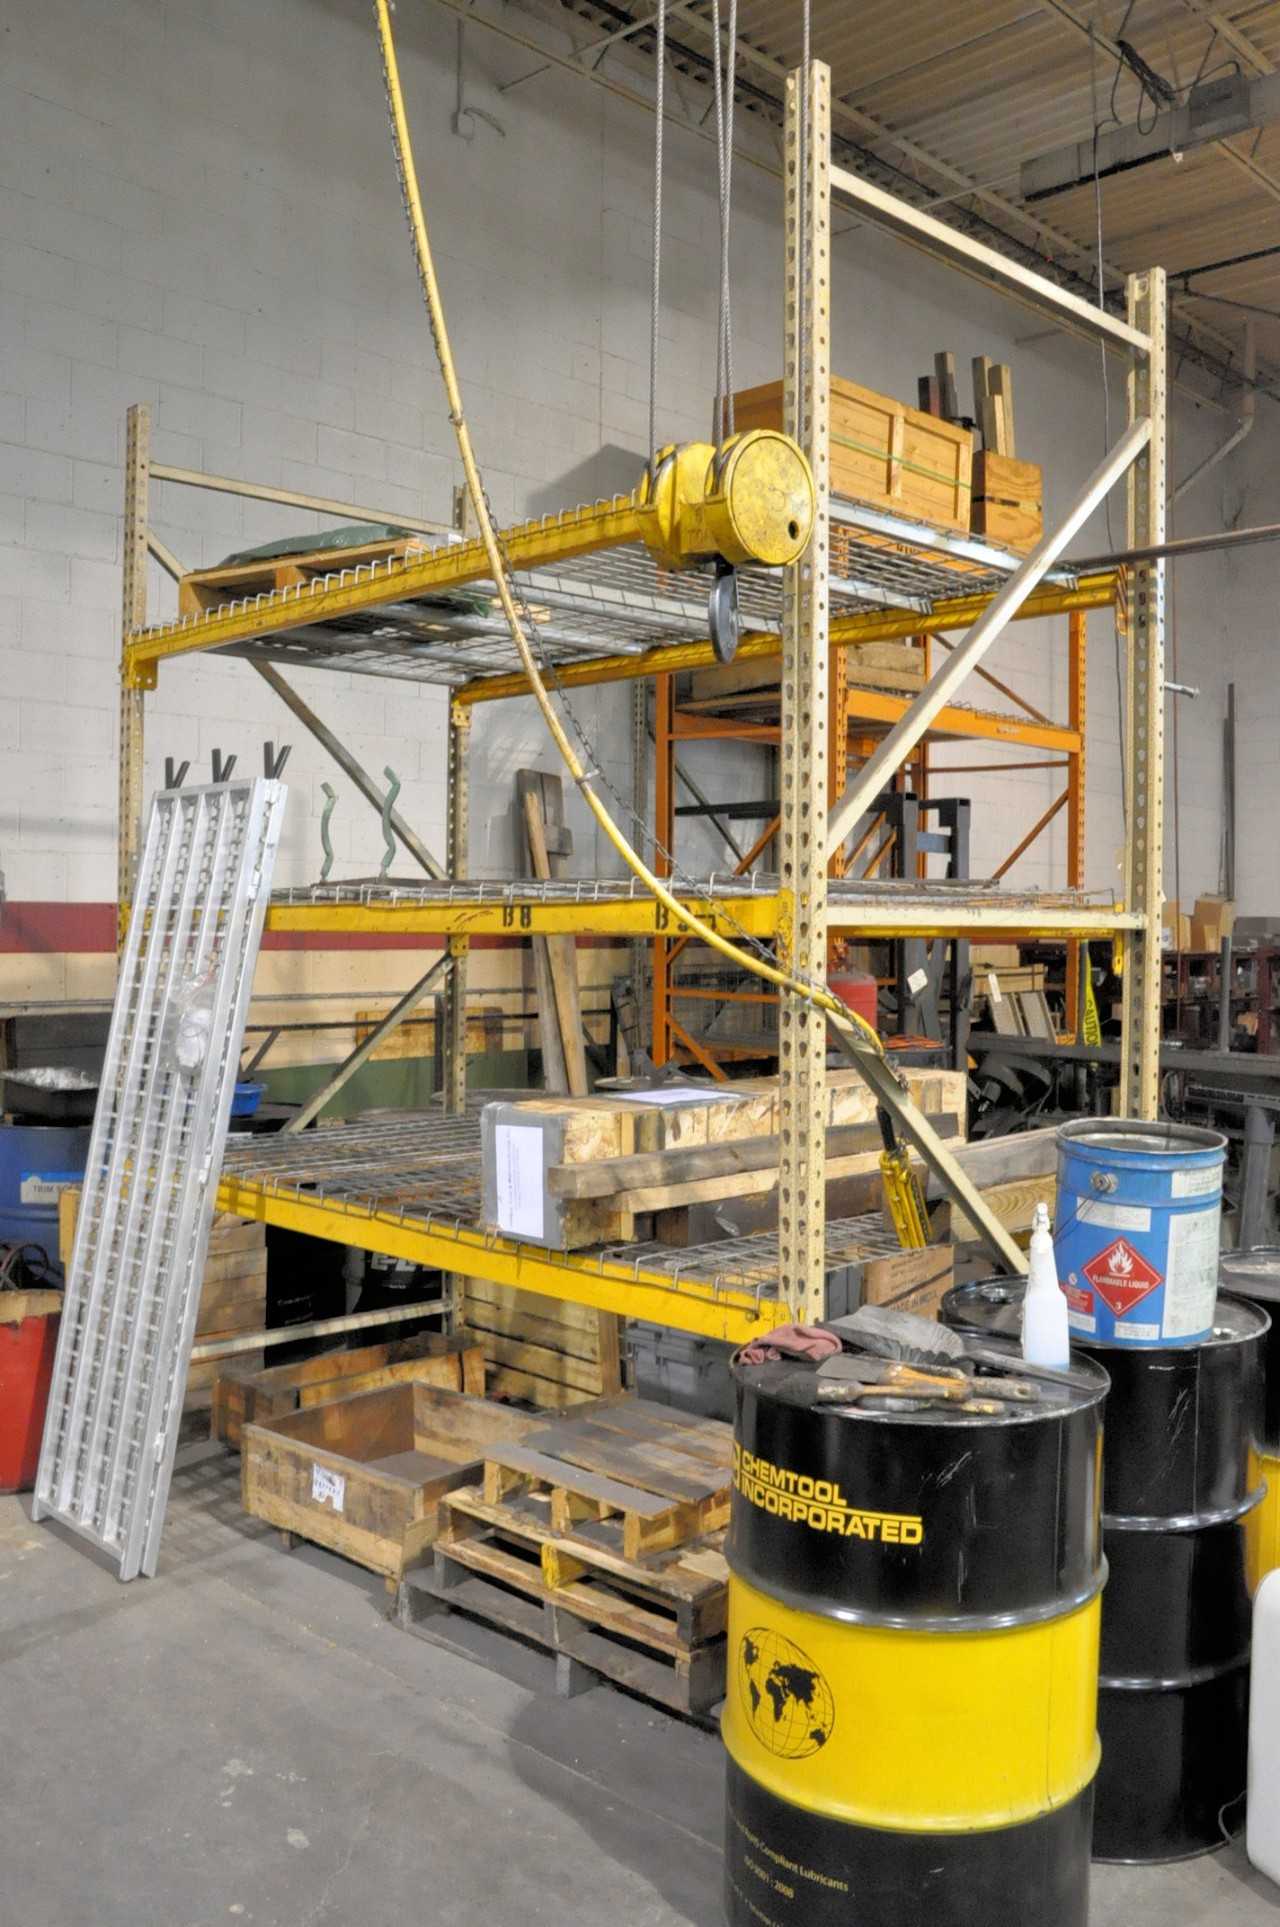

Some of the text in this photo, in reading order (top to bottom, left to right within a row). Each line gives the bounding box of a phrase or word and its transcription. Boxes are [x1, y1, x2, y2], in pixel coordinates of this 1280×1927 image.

[742, 1450, 847, 1506] CHEMTOOL
[741, 1479, 924, 1545] INCORPORATED
[799, 1865, 849, 1893] Lubricants
